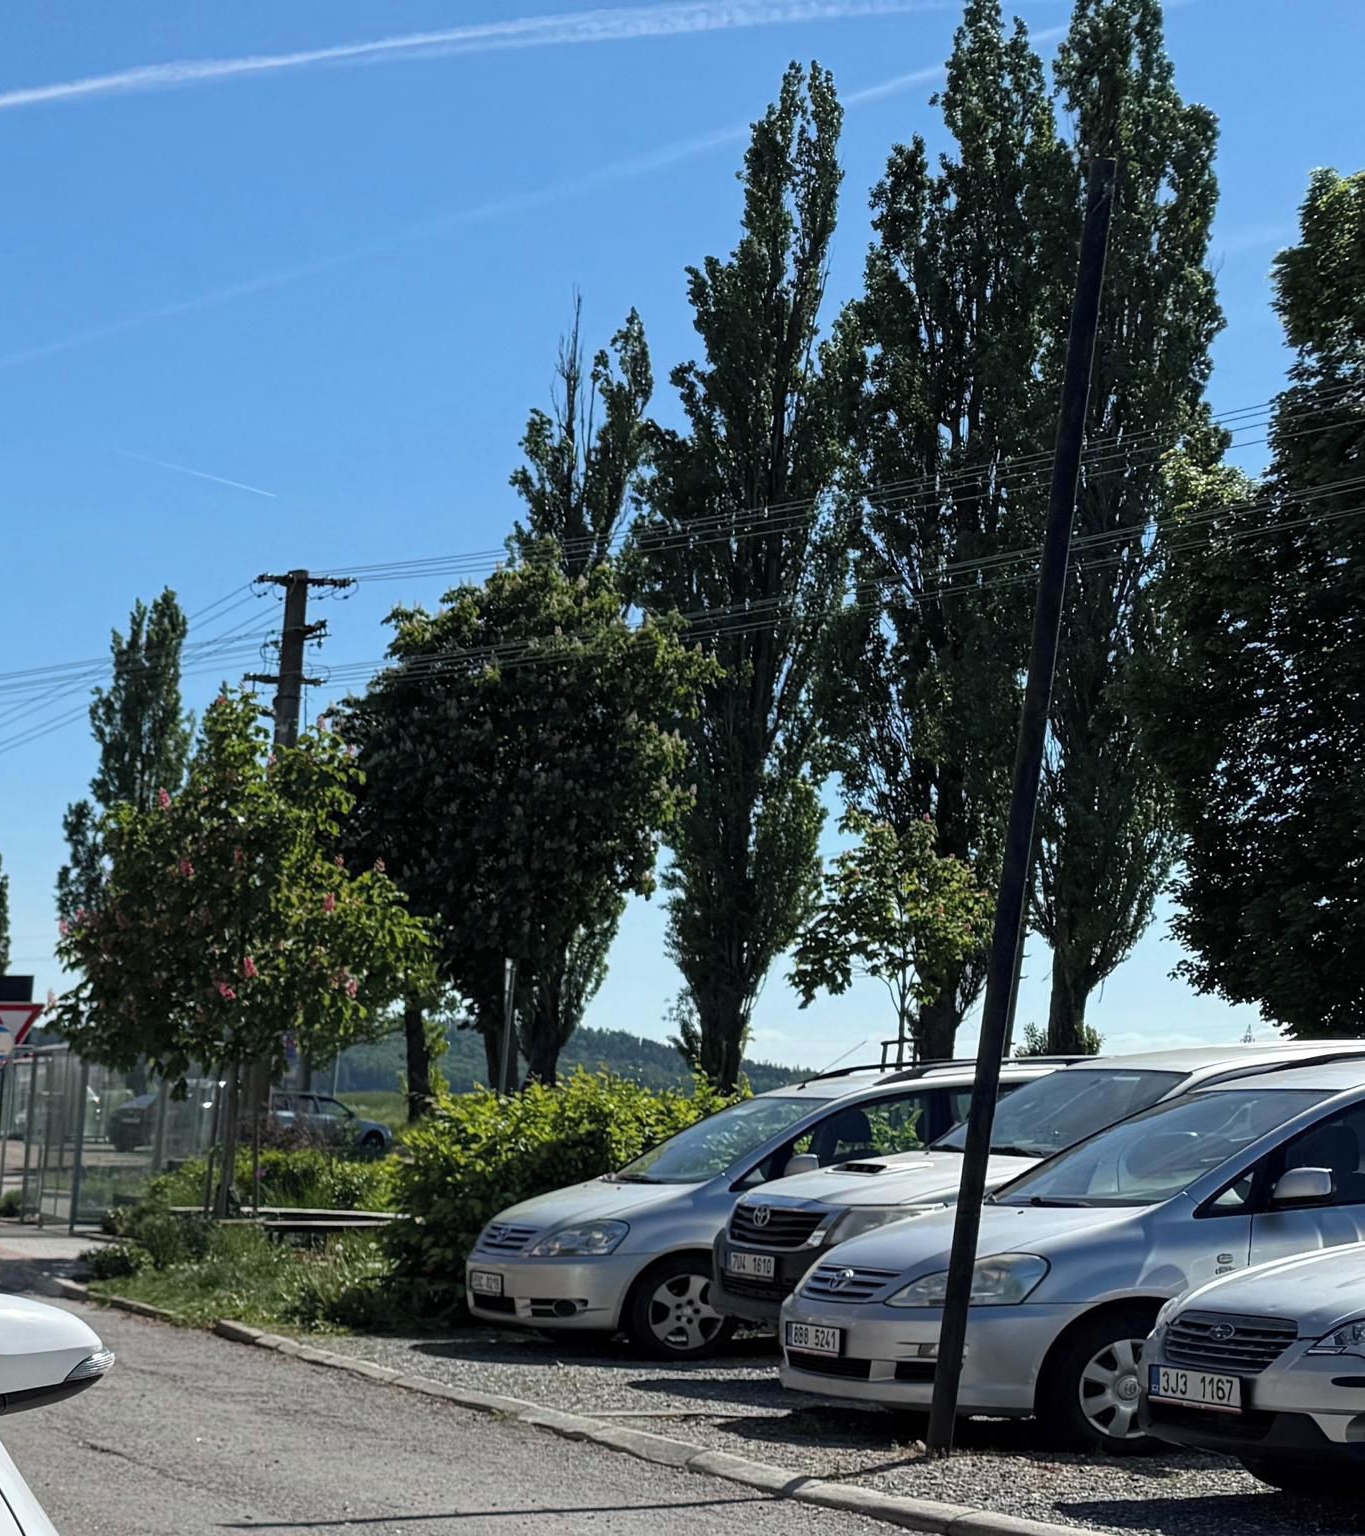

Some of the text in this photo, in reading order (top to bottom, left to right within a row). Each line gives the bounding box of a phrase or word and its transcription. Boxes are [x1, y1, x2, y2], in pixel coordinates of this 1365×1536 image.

[815, 1329, 836, 1349] 5241
[1162, 1371, 1234, 1402] 3J3 1167
